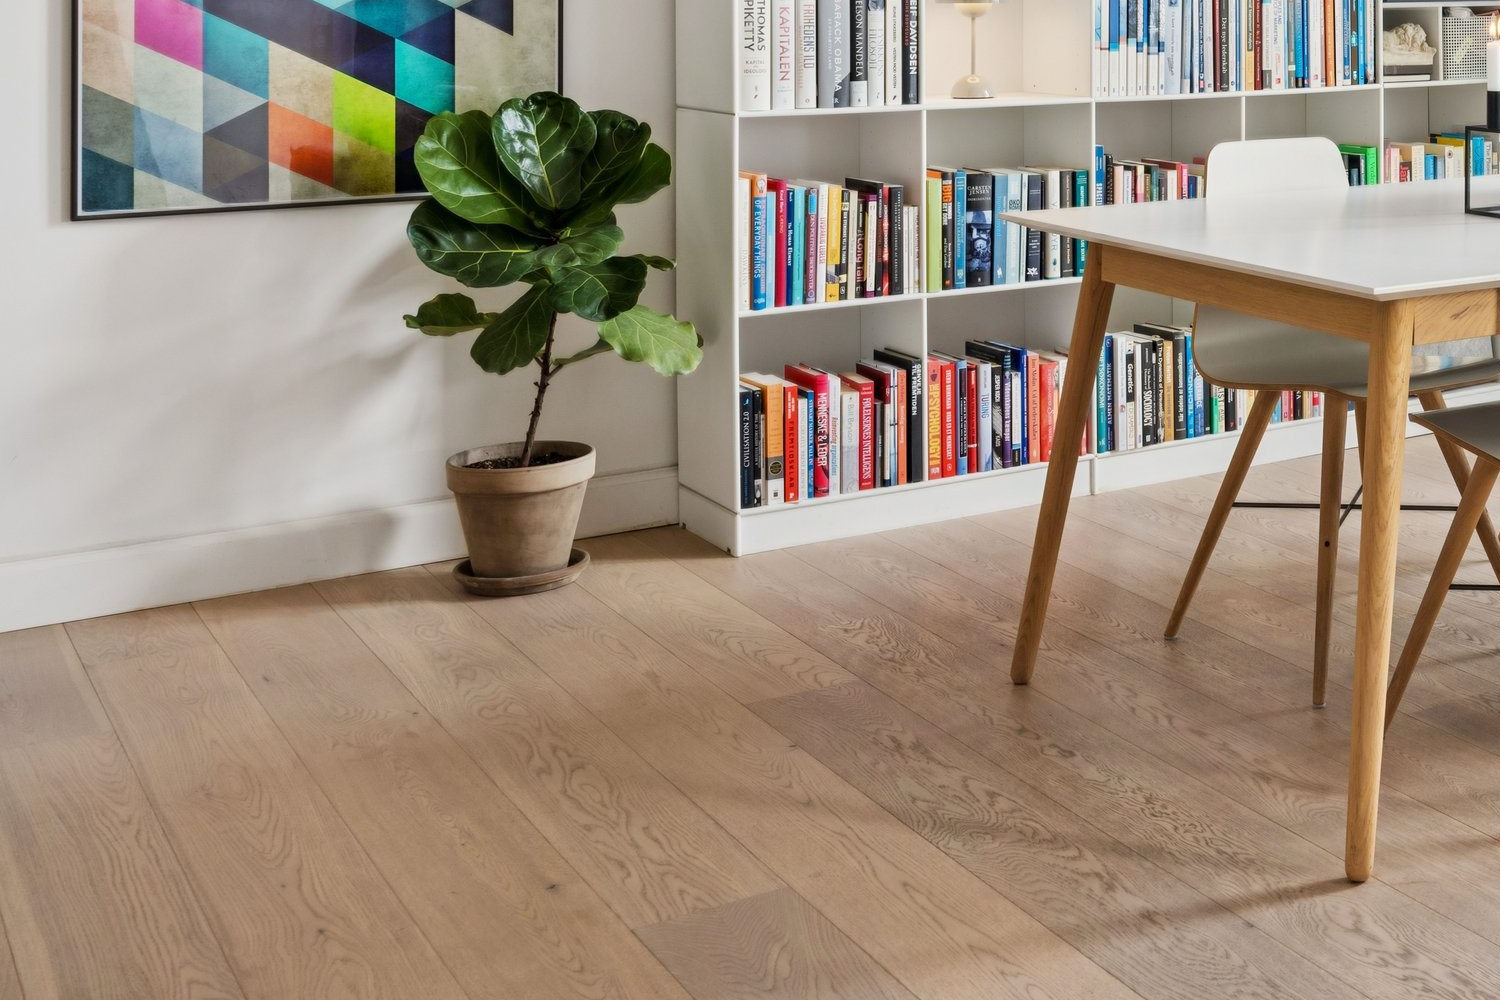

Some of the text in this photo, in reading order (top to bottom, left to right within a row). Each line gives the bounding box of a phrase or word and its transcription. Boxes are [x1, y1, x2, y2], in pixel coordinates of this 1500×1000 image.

[744, 0, 754, 51] PIKETTY
[757, 0, 766, 51] THOMAS
[779, 7, 791, 81] KAPITALEN
[803, 4, 815, 69] FRIHEDENS ILD
[834, 48, 842, 91] OBAMA
[856, 32, 864, 77] MANDELA
[909, 21, 917, 75] DAVIDSEN
[754, 200, 761, 208] OF
[943, 185, 952, 202] BIG
[856, 238, 864, 282] Long Tail
[817, 393, 827, 433] MENNESKE
[862, 397, 871, 439] FØLELSERNES
[929, 391, 939, 458] PSYCHOLOGY
[981, 394, 989, 418] TURING
[1144, 390, 1152, 426] SOCIOLOGY
[831, 417, 839, 476] Reinventing organizations
[847, 418, 855, 443] Bryson
[818, 443, 827, 466] LEDER
[862, 441, 871, 479] INTELLIGENS
